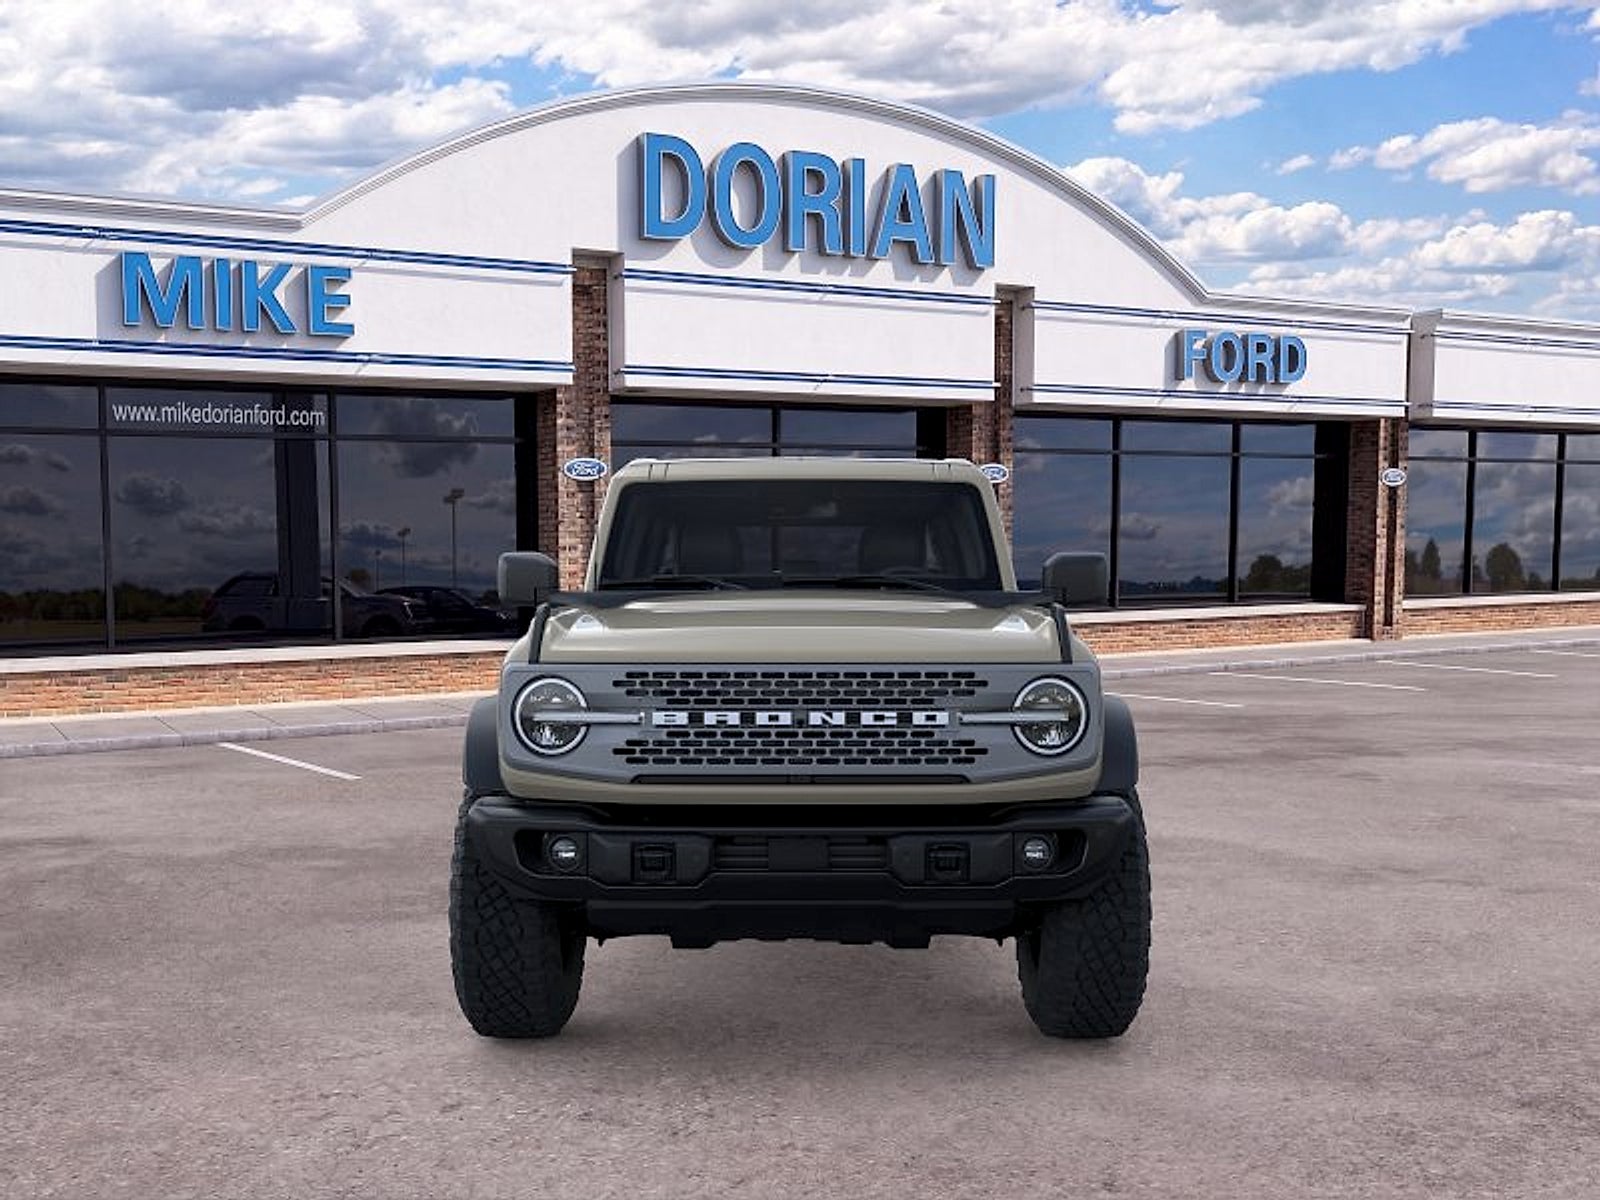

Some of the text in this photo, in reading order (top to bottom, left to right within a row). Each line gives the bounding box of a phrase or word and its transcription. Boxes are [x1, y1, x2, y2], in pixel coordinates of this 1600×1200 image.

[640, 132, 995, 269] DORIAN
[121, 251, 354, 337] MIKE
[1177, 328, 1307, 384] FORD
[111, 402, 325, 427] www.mikedorianford.com
[651, 711, 949, 726] BRONCO
